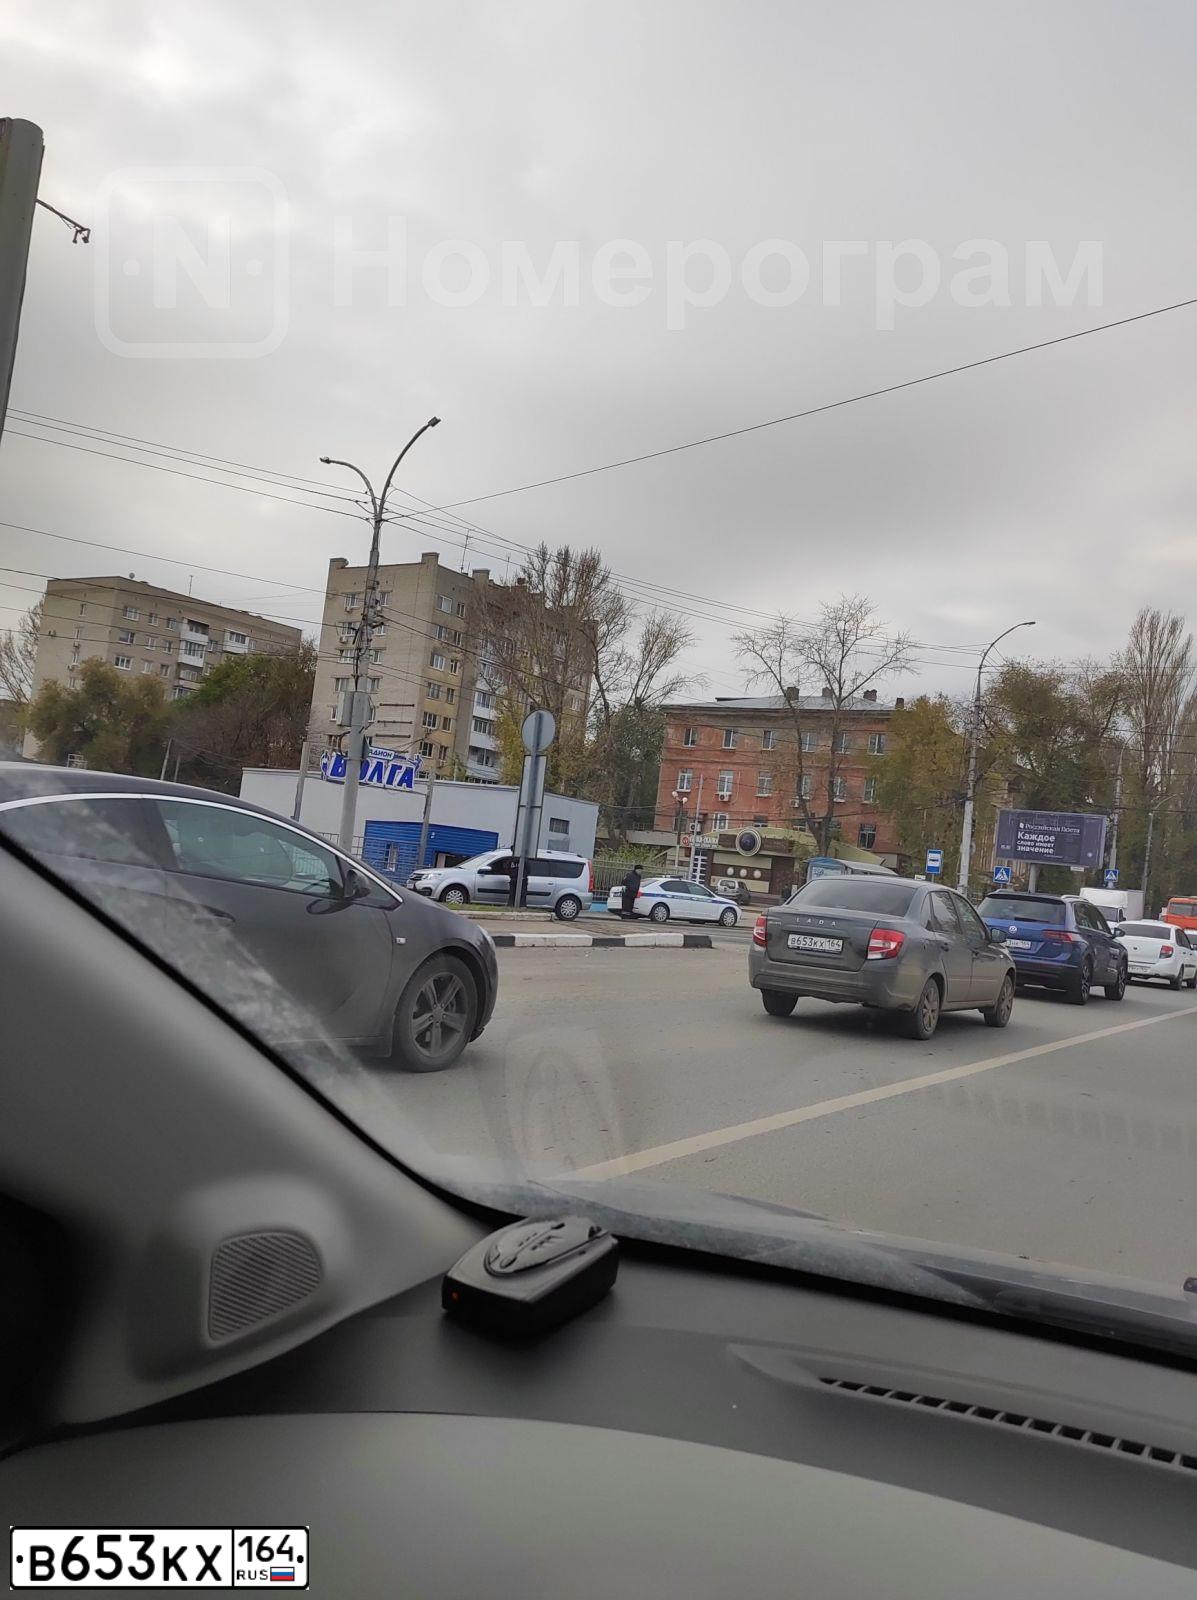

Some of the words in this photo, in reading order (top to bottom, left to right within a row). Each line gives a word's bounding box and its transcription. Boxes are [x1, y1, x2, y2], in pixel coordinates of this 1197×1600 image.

[1017, 831, 1056, 842] Каждое
[1016, 846, 1054, 854] значение
[796, 917, 836, 926] LADA
[790, 936, 825, 948] В653КХ
[826, 939, 841, 949] 164
